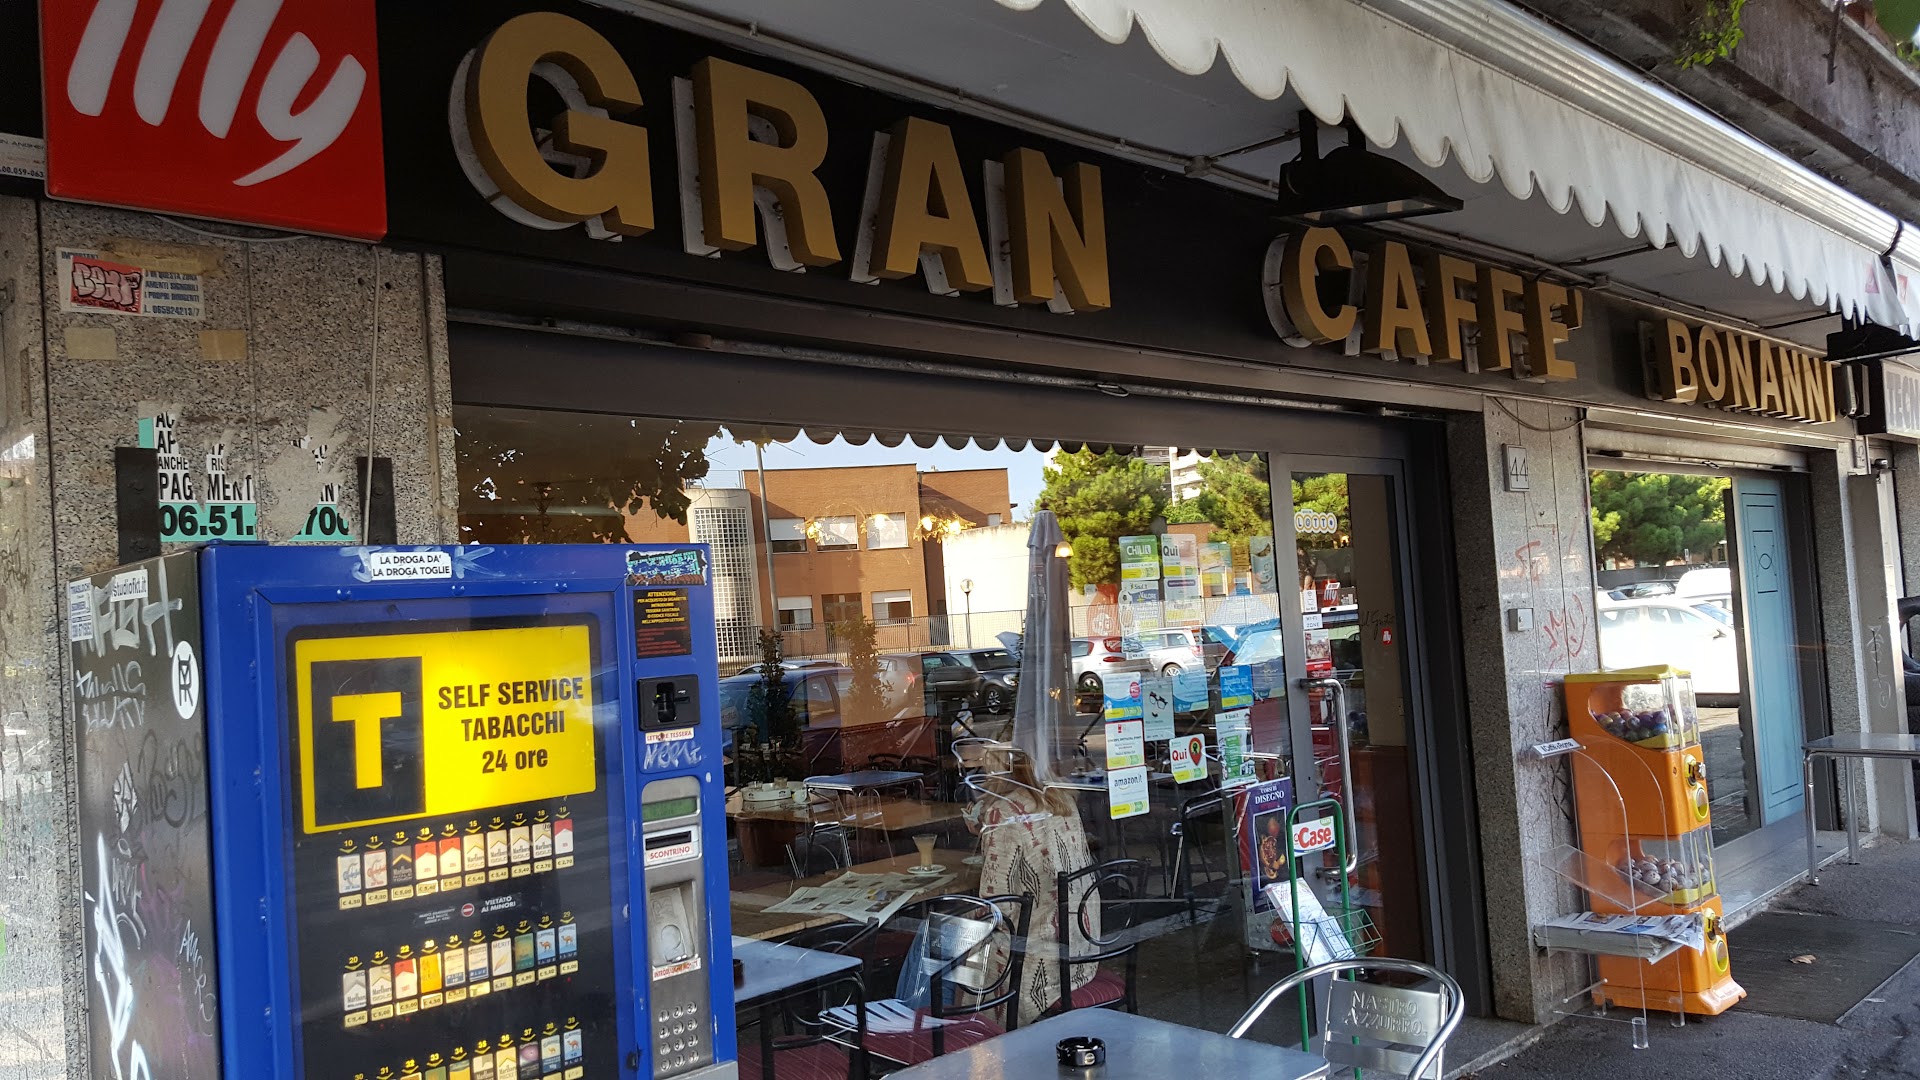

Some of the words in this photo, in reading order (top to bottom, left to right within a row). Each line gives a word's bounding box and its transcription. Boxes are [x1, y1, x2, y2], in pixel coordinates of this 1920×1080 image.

[462, 11, 1111, 313] GRAN
[1664, 318, 1836, 424] BONANNI
[1510, 457, 1528, 482] 44
[1162, 545, 1179, 557] Qui
[380, 556, 392, 565] LA
[393, 554, 426, 565] DROGA
[372, 568, 385, 577] LA
[386, 567, 418, 576] DROGA
[420, 565, 450, 575] TOGLIE
[438, 683, 491, 710] SELF
[498, 677, 584, 706] SERVICE
[461, 710, 565, 742] TABACCHI
[331, 691, 402, 789] T
[670, 730, 693, 740] TESSERA
[482, 749, 508, 774] 24
[515, 748, 548, 770] ore
[1172, 748, 1188, 761] Qui
[1255, 790, 1285, 804] DISEGNO
[445, 823, 454, 831] 14
[396, 831, 405, 839] 12
[1299, 827, 1332, 849] Case
[649, 846, 691, 860] SCONTRINO
[484, 896, 512, 906] VIETATO
[490, 901, 516, 911] MINORI
[449, 935, 459, 943] 24
[349, 956, 358, 964] 20
[374, 950, 384, 959] 21
[1351, 990, 1418, 1016] NASTRO
